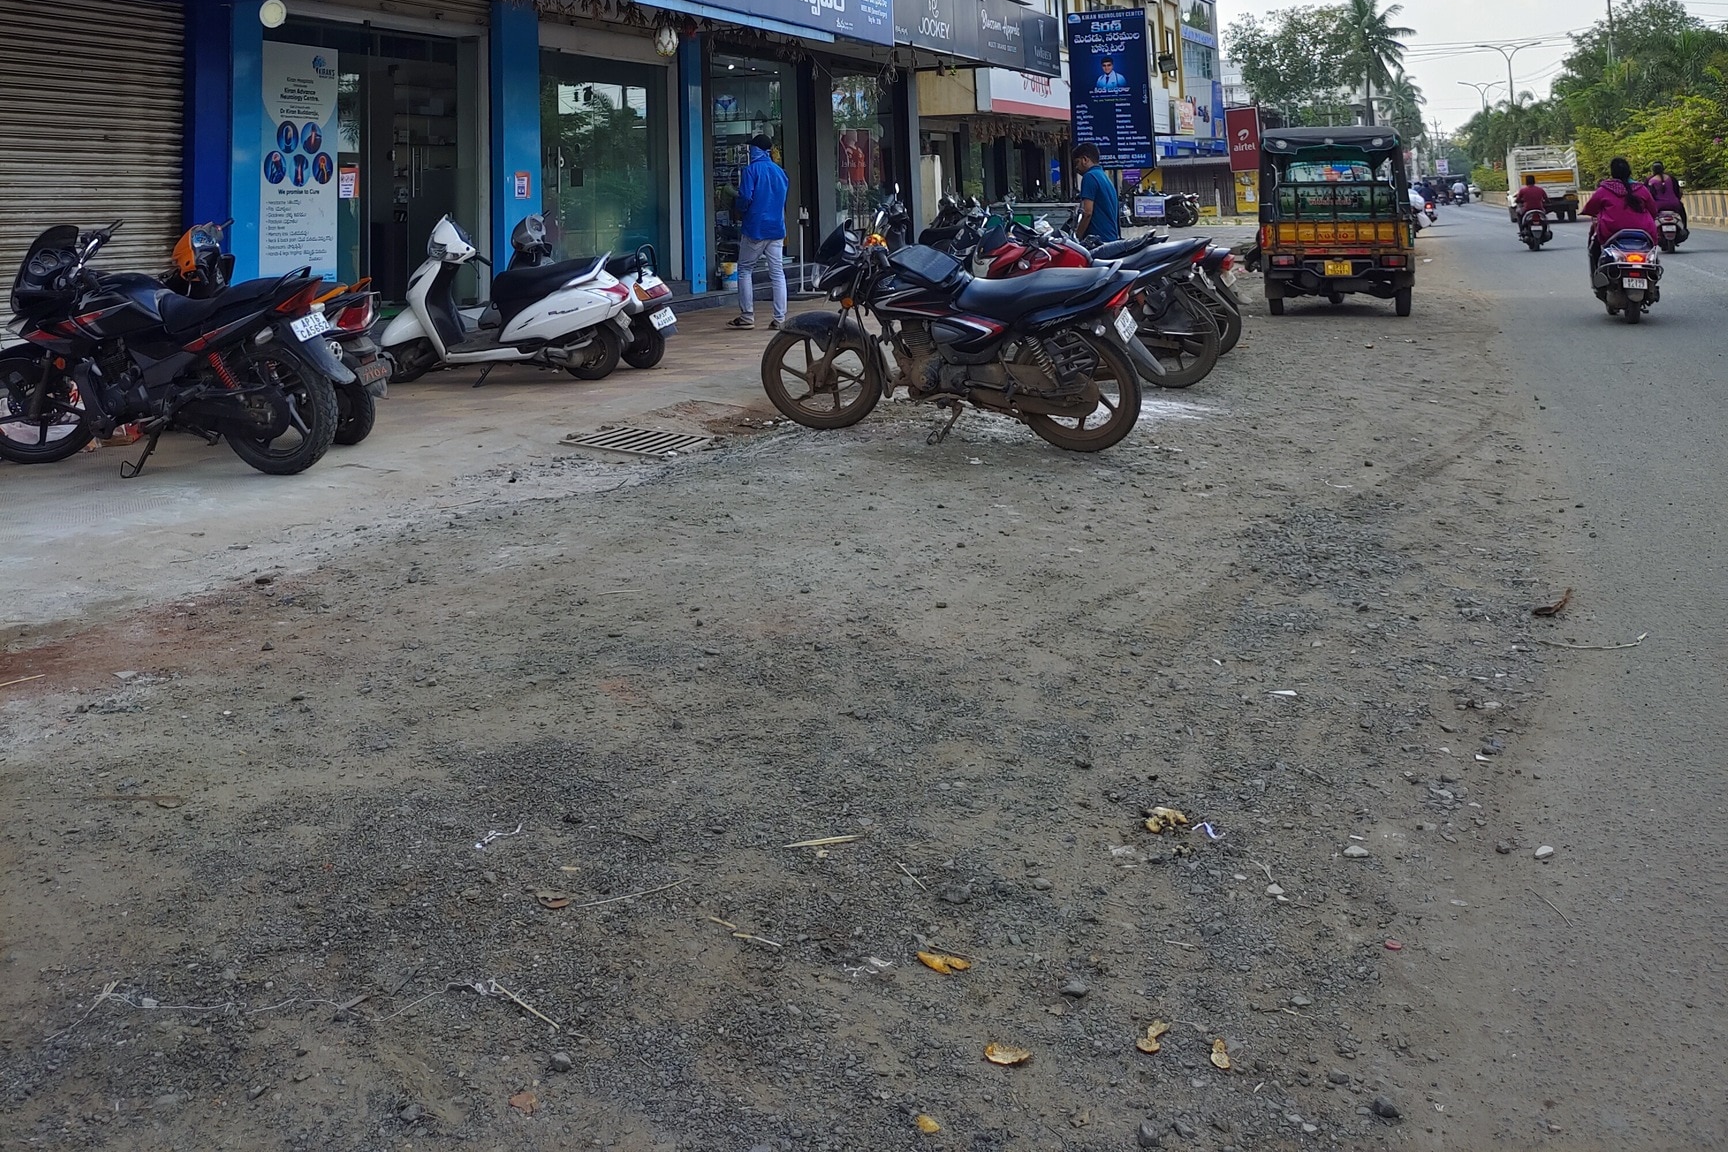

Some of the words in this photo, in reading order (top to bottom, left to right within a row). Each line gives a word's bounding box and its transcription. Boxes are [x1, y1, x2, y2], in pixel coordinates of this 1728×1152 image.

[918, 16, 950, 40] JOCKEY
[1090, 19, 1122, 33] కిరణ్
[1233, 142, 1256, 152] airtel
[301, 314, 320, 328] AP16
[300, 320, 329, 338] CA5652
